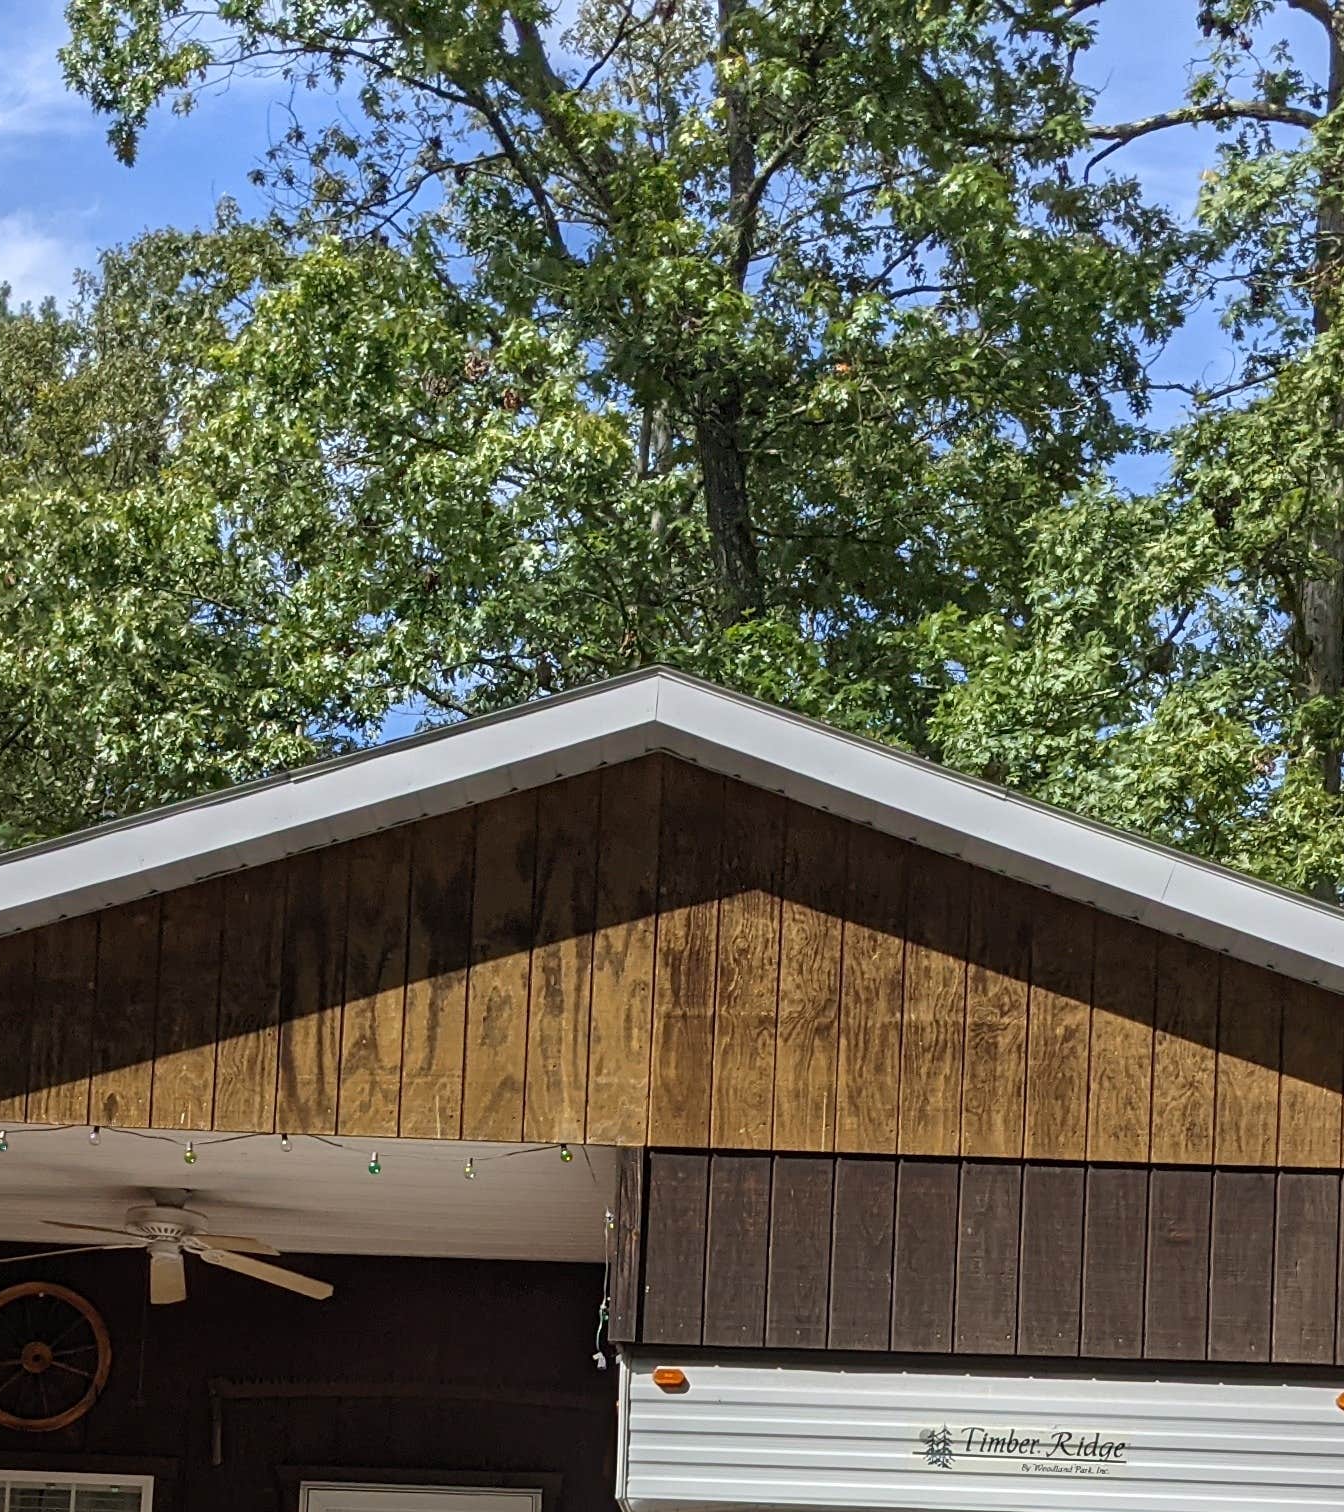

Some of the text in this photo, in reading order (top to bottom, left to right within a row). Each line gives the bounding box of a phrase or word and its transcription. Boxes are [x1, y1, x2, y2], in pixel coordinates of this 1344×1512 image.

[1046, 1431, 1126, 1461] Ridge
[1021, 1463, 1032, 1472] By
[1034, 1463, 1073, 1473] Woodland
